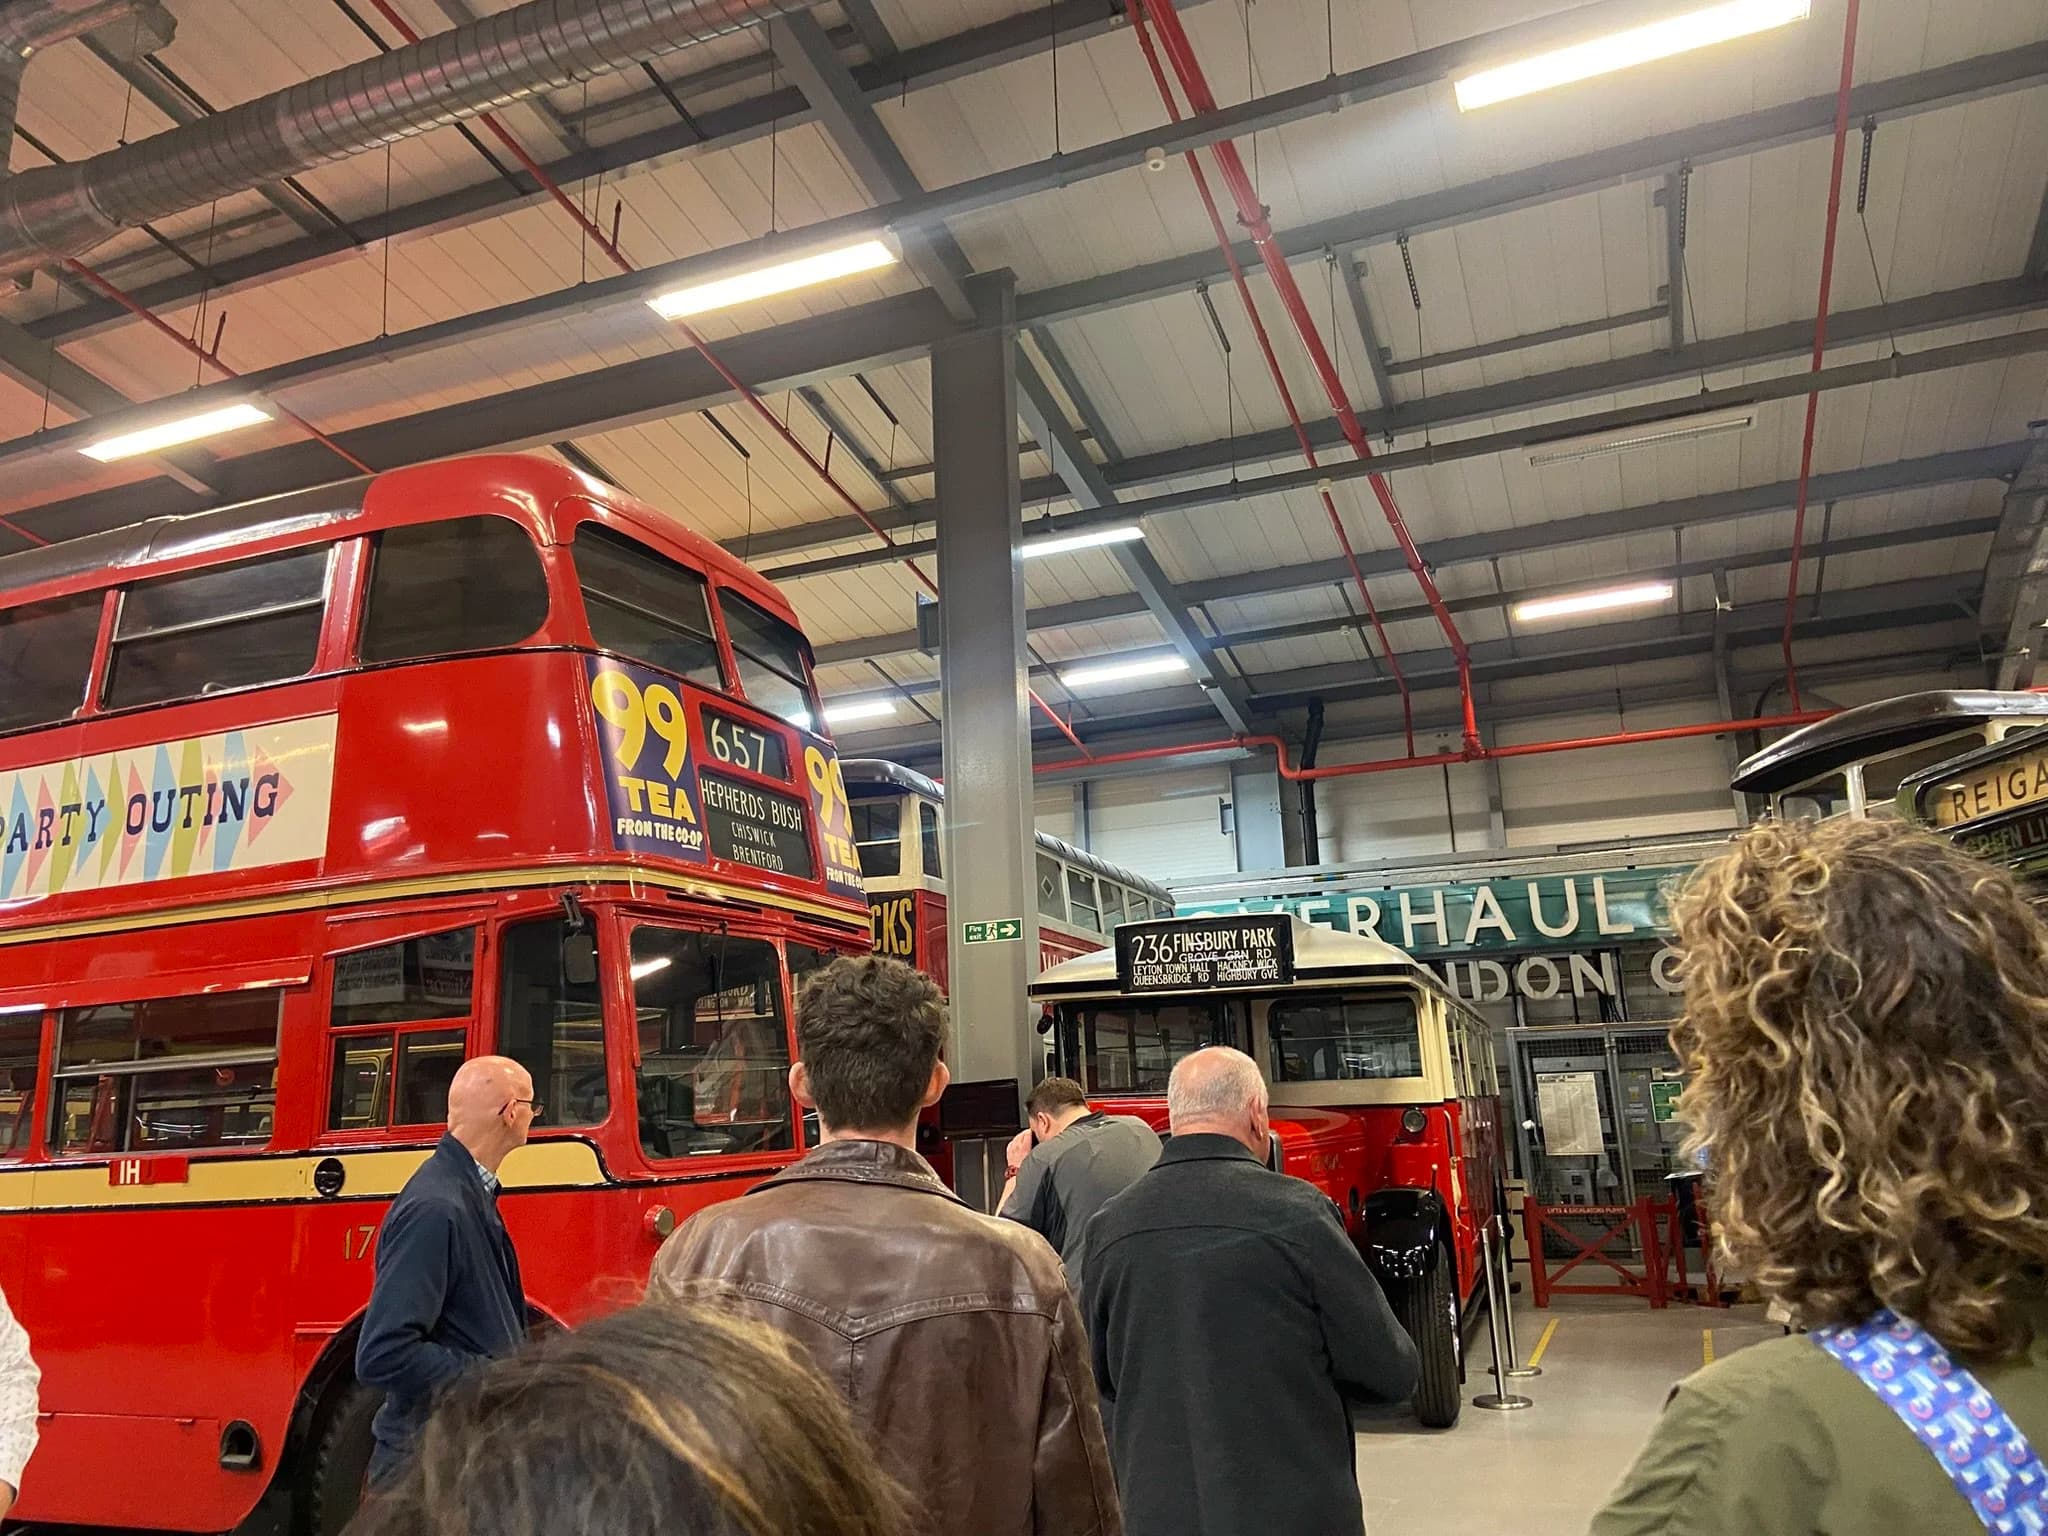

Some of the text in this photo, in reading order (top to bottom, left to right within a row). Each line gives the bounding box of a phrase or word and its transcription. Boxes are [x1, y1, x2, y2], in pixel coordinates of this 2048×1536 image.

[591, 670, 687, 782] 99
[711, 717, 767, 774] 657
[125, 772, 280, 836] OUTING
[617, 776, 697, 825] TEA
[771, 800, 802, 832] BUSH
[617, 817, 703, 847] FROM THE CO-OP
[731, 821, 777, 848] CHISWICK
[732, 843, 784, 871] BRENTFORD
[826, 866, 844, 884] FROM
[1190, 877, 1634, 949] ERHAUL
[1131, 933, 1173, 965] 236
[1173, 927, 1277, 953] FINSBURY PARK
[1133, 958, 1278, 976] LEYTON TOWN HALL HACKNEY WICK
[1179, 948, 1272, 964] GROVE GRN RD
[1133, 968, 1279, 986] QUEENSBRIDGE RD HIGHBURY GVE
